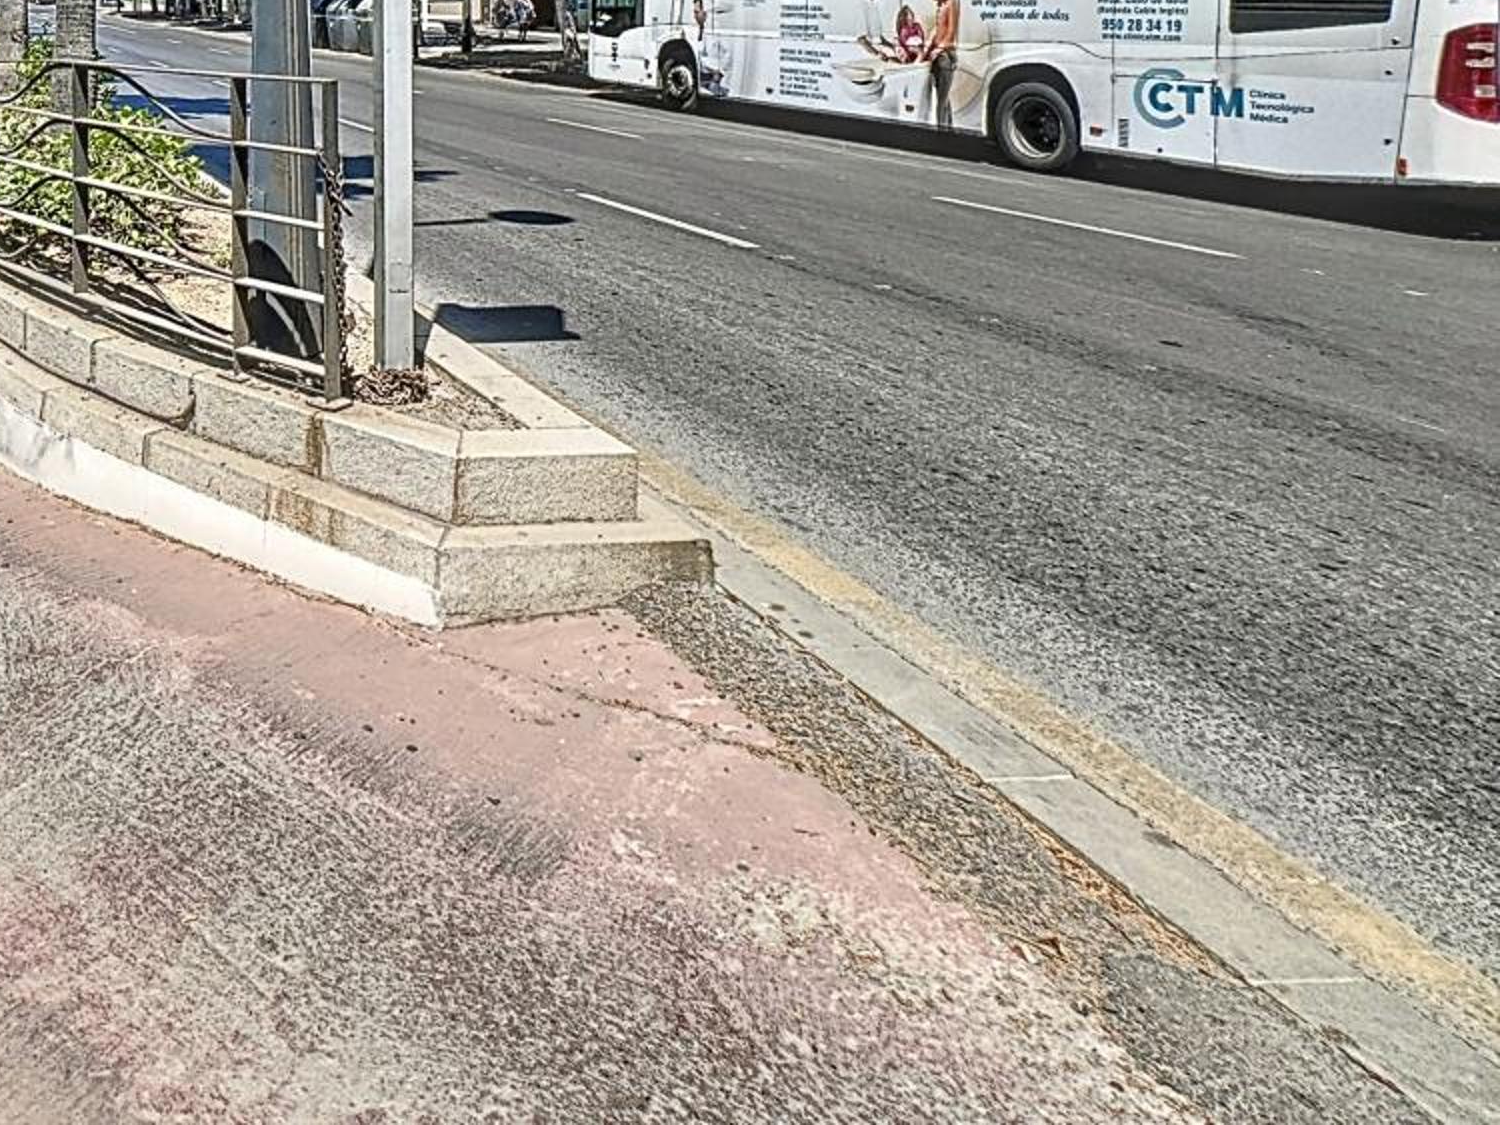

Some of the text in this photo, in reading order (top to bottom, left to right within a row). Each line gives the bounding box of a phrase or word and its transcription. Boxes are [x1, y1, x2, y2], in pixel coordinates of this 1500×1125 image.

[1101, 18, 1182, 33] 950 28 34 19
